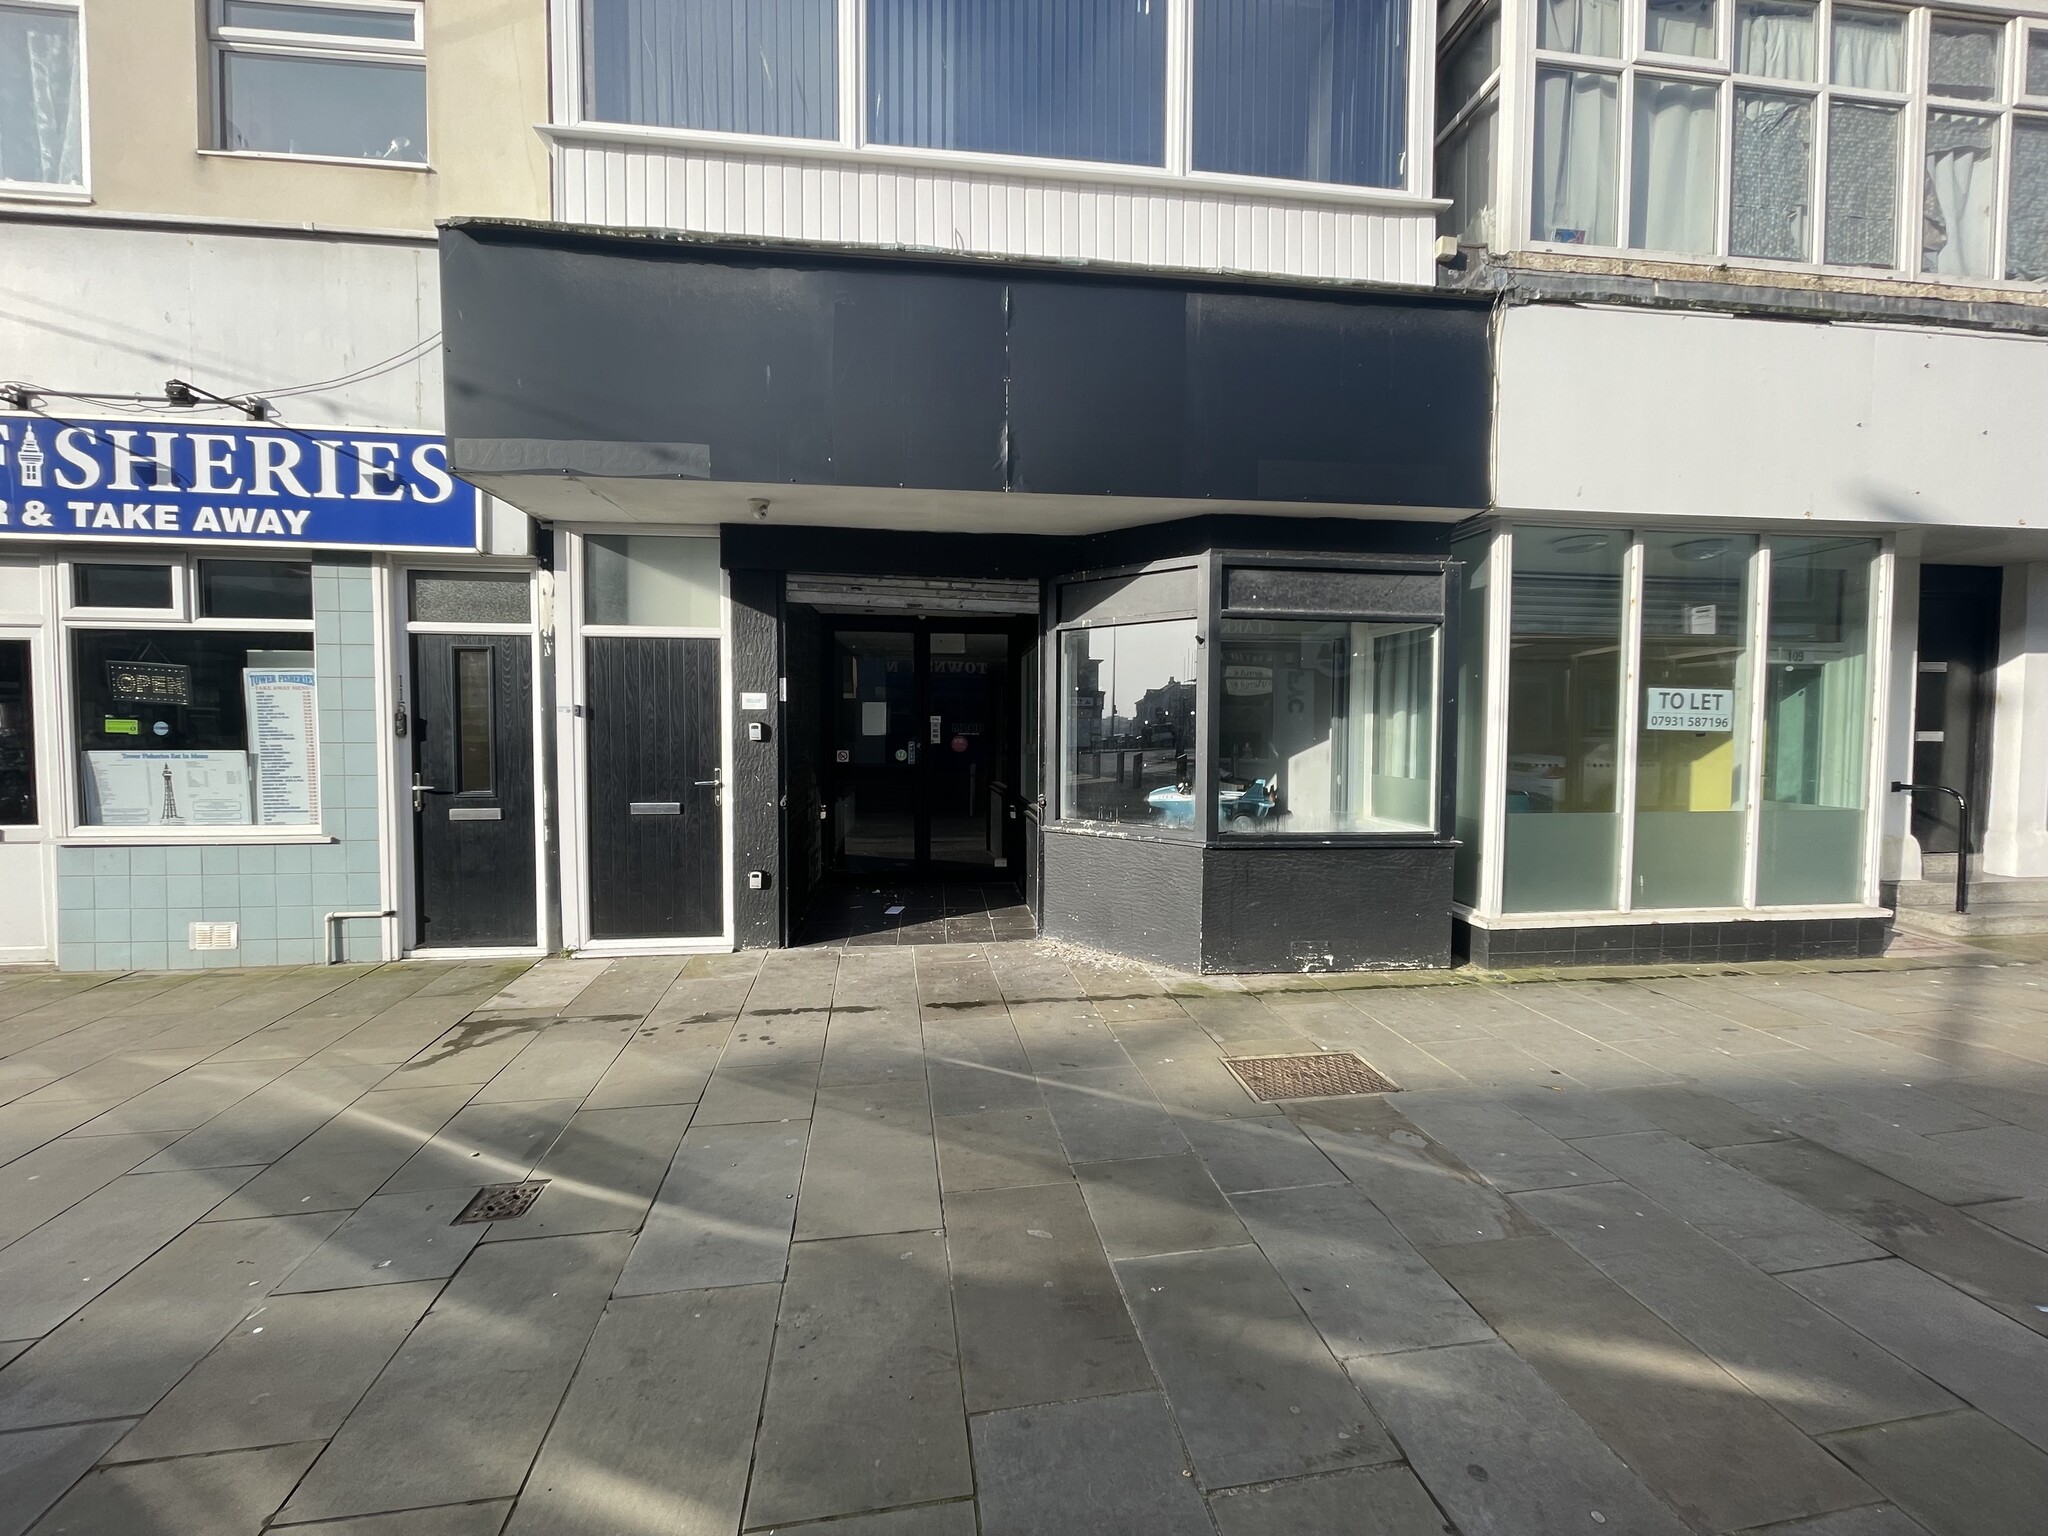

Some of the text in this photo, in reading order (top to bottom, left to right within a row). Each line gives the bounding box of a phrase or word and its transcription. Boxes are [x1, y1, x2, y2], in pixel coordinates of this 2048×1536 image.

[20, 500, 55, 527] &
[67, 501, 181, 531] TAKE
[192, 505, 313, 536] AWAY
[116, 673, 183, 695] OPEN
[249, 673, 315, 687] TOWER FISHERIES
[1658, 691, 1724, 711] TO LET
[1650, 716, 1729, 728] 07931 587196
